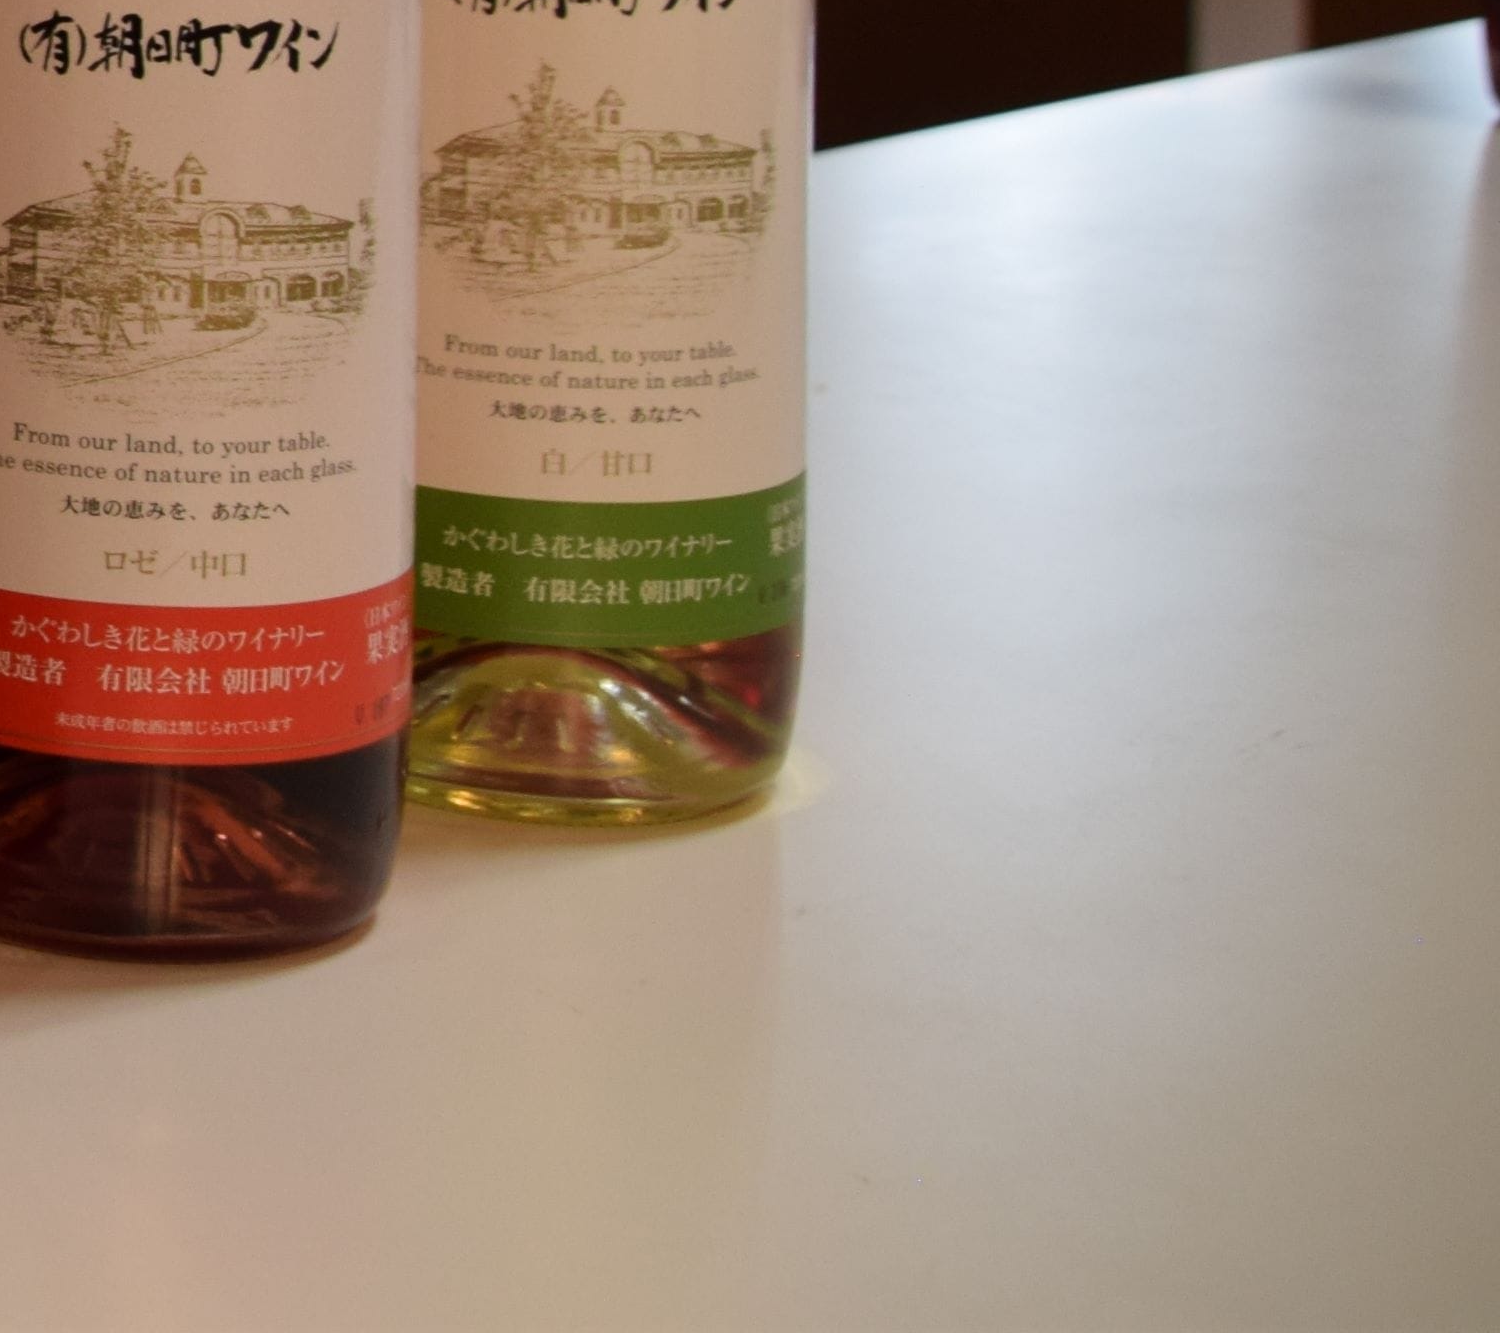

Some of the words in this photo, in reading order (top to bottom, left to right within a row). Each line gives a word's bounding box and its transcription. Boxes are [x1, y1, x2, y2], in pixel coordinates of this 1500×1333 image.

[12, 421, 75, 449] From
[79, 433, 118, 452] our
[125, 433, 184, 457] land,
[193, 437, 216, 455] to
[221, 436, 272, 459] your
[277, 429, 331, 452] table.
[22, 455, 108, 480] essence
[114, 461, 138, 482] of
[144, 465, 223, 485] nature
[229, 464, 252, 485] in
[257, 459, 305, 482] each
[310, 455, 358, 483] glass.
[523, 576, 631, 605] 有限会社
[11, 614, 325, 653] かぐわしき花と緑のワイナリー
[98, 662, 212, 695] 有限会社
[221, 657, 345, 696] 朝日町ワイン
